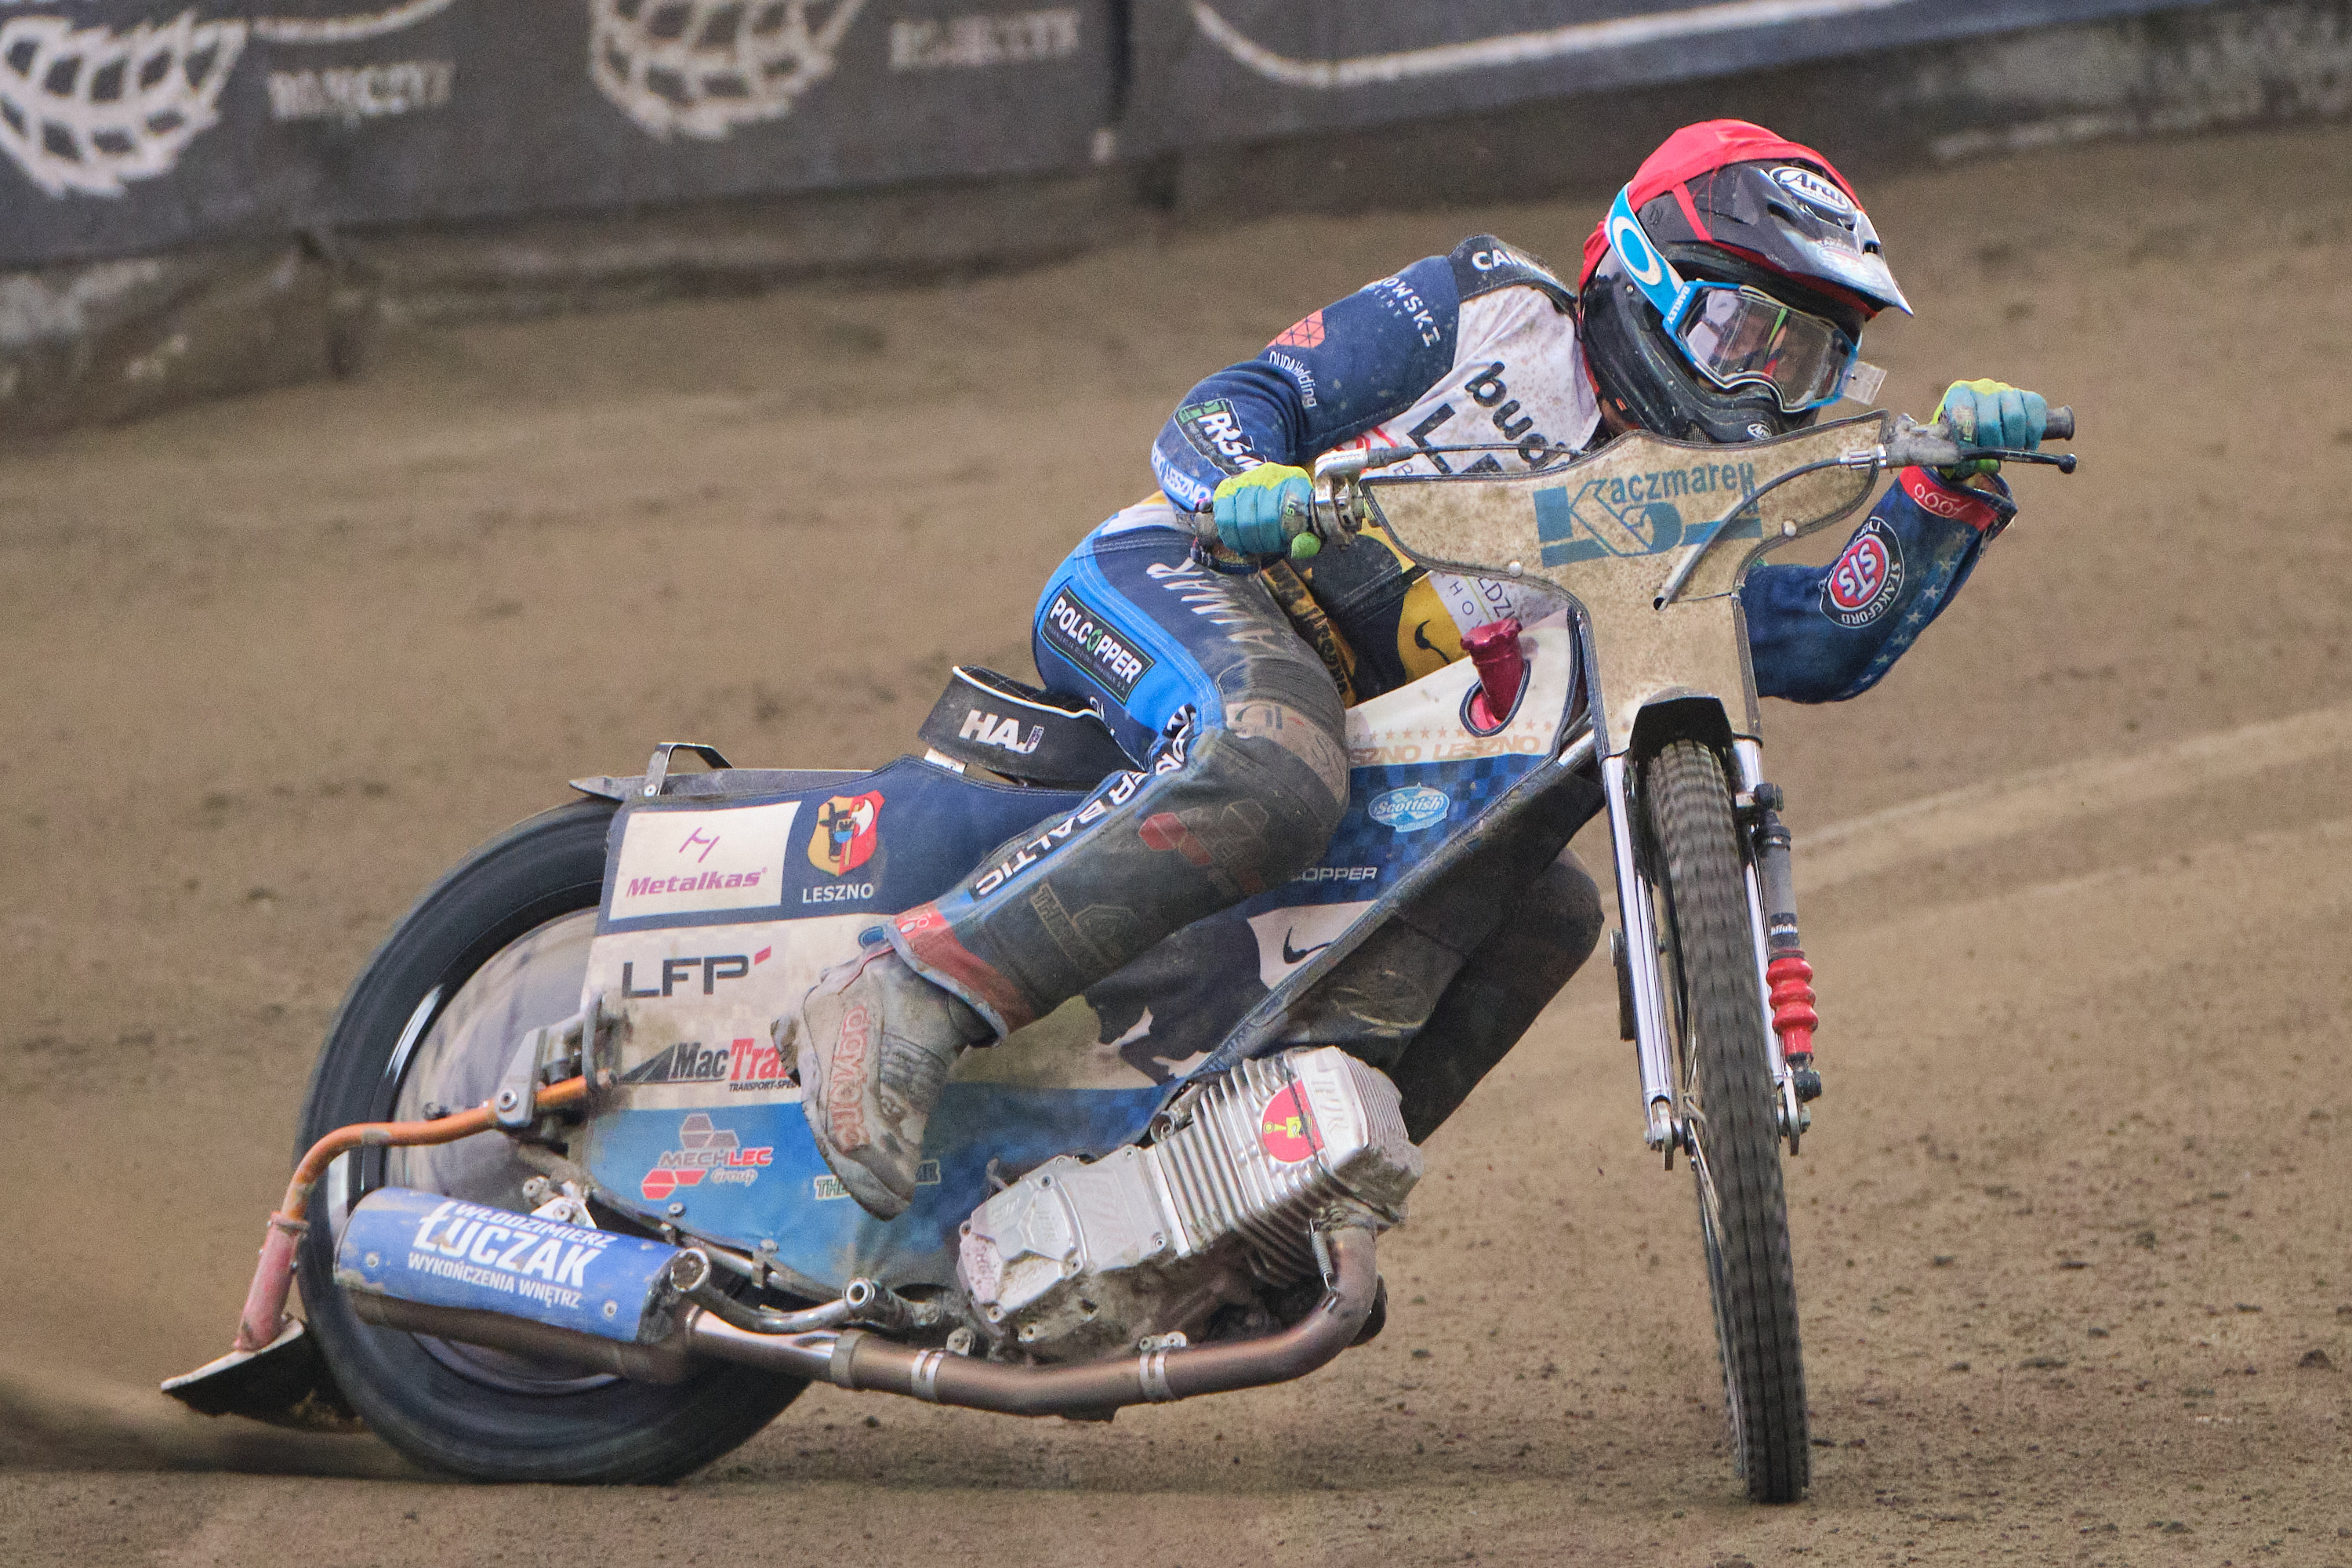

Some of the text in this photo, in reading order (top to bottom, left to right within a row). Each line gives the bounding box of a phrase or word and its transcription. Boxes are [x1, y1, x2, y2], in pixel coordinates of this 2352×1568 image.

[1666, 285, 1691, 325] OAKLEY
[1841, 561, 1900, 625] STAKEFORD
[1049, 596, 1143, 684] POLCOPPER
[959, 709, 1045, 754] HAJ
[1377, 795, 1444, 815] Scottish
[975, 799, 1106, 896] BALTIC
[802, 883, 875, 904] LESZNO
[621, 953, 750, 1000] LFP
[668, 1037, 791, 1081] MacTra
[658, 1146, 774, 1168] MECHLEC
[710, 1168, 758, 1187] Group
[412, 1200, 603, 1287] ŁUCZAK
[455, 1203, 619, 1249] WŁODZIMIERZ
[407, 1250, 583, 1308] WYKOŃCZENIA WNĘTRZ
